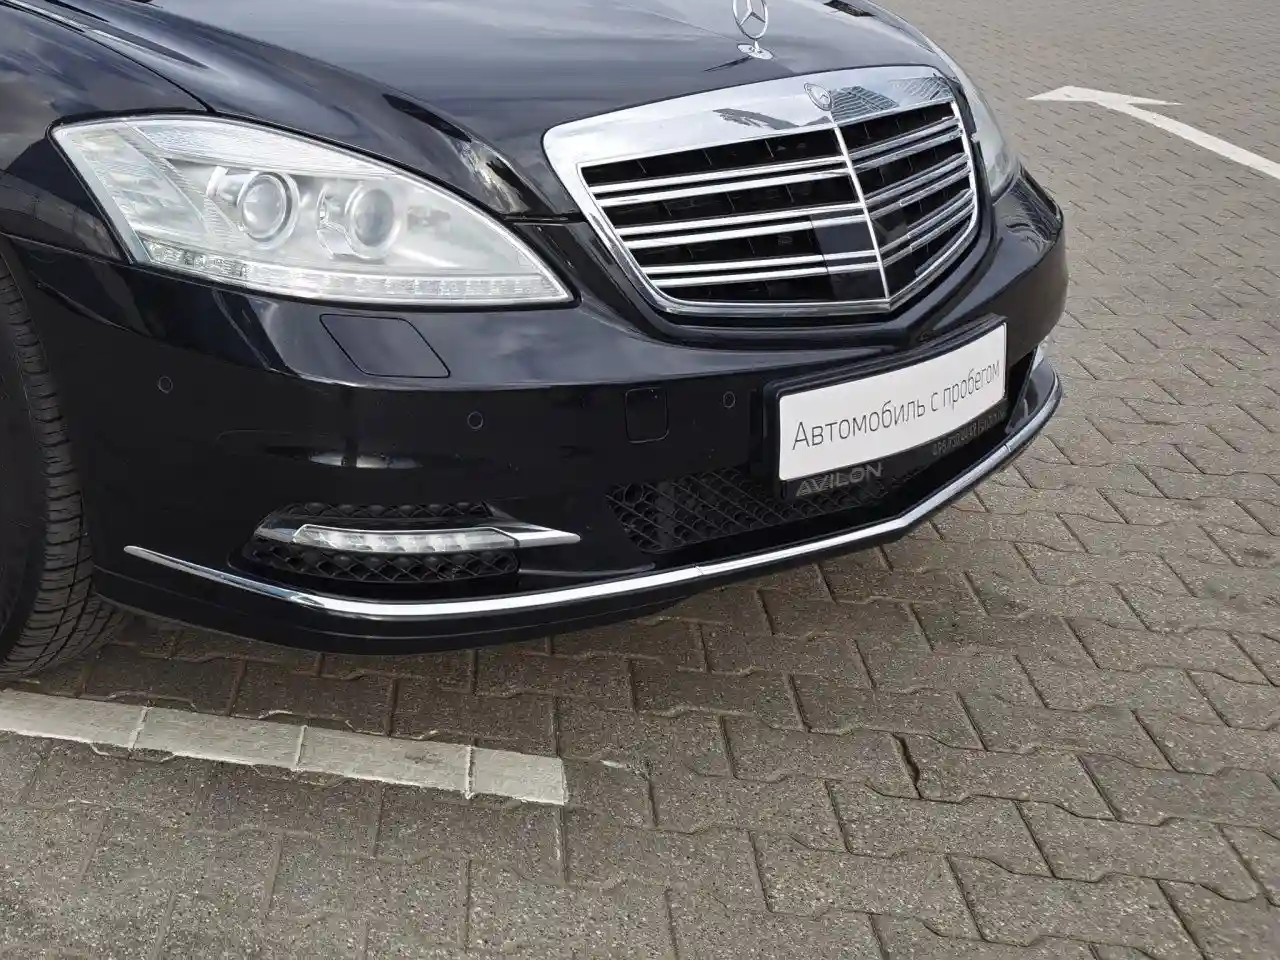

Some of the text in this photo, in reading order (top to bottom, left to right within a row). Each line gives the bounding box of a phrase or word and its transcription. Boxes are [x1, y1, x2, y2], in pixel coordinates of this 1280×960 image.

[791, 399, 926, 451] Автомобиль
[930, 392, 939, 412] с
[943, 359, 1001, 411] пробегом
[795, 462, 884, 497] AVILON
